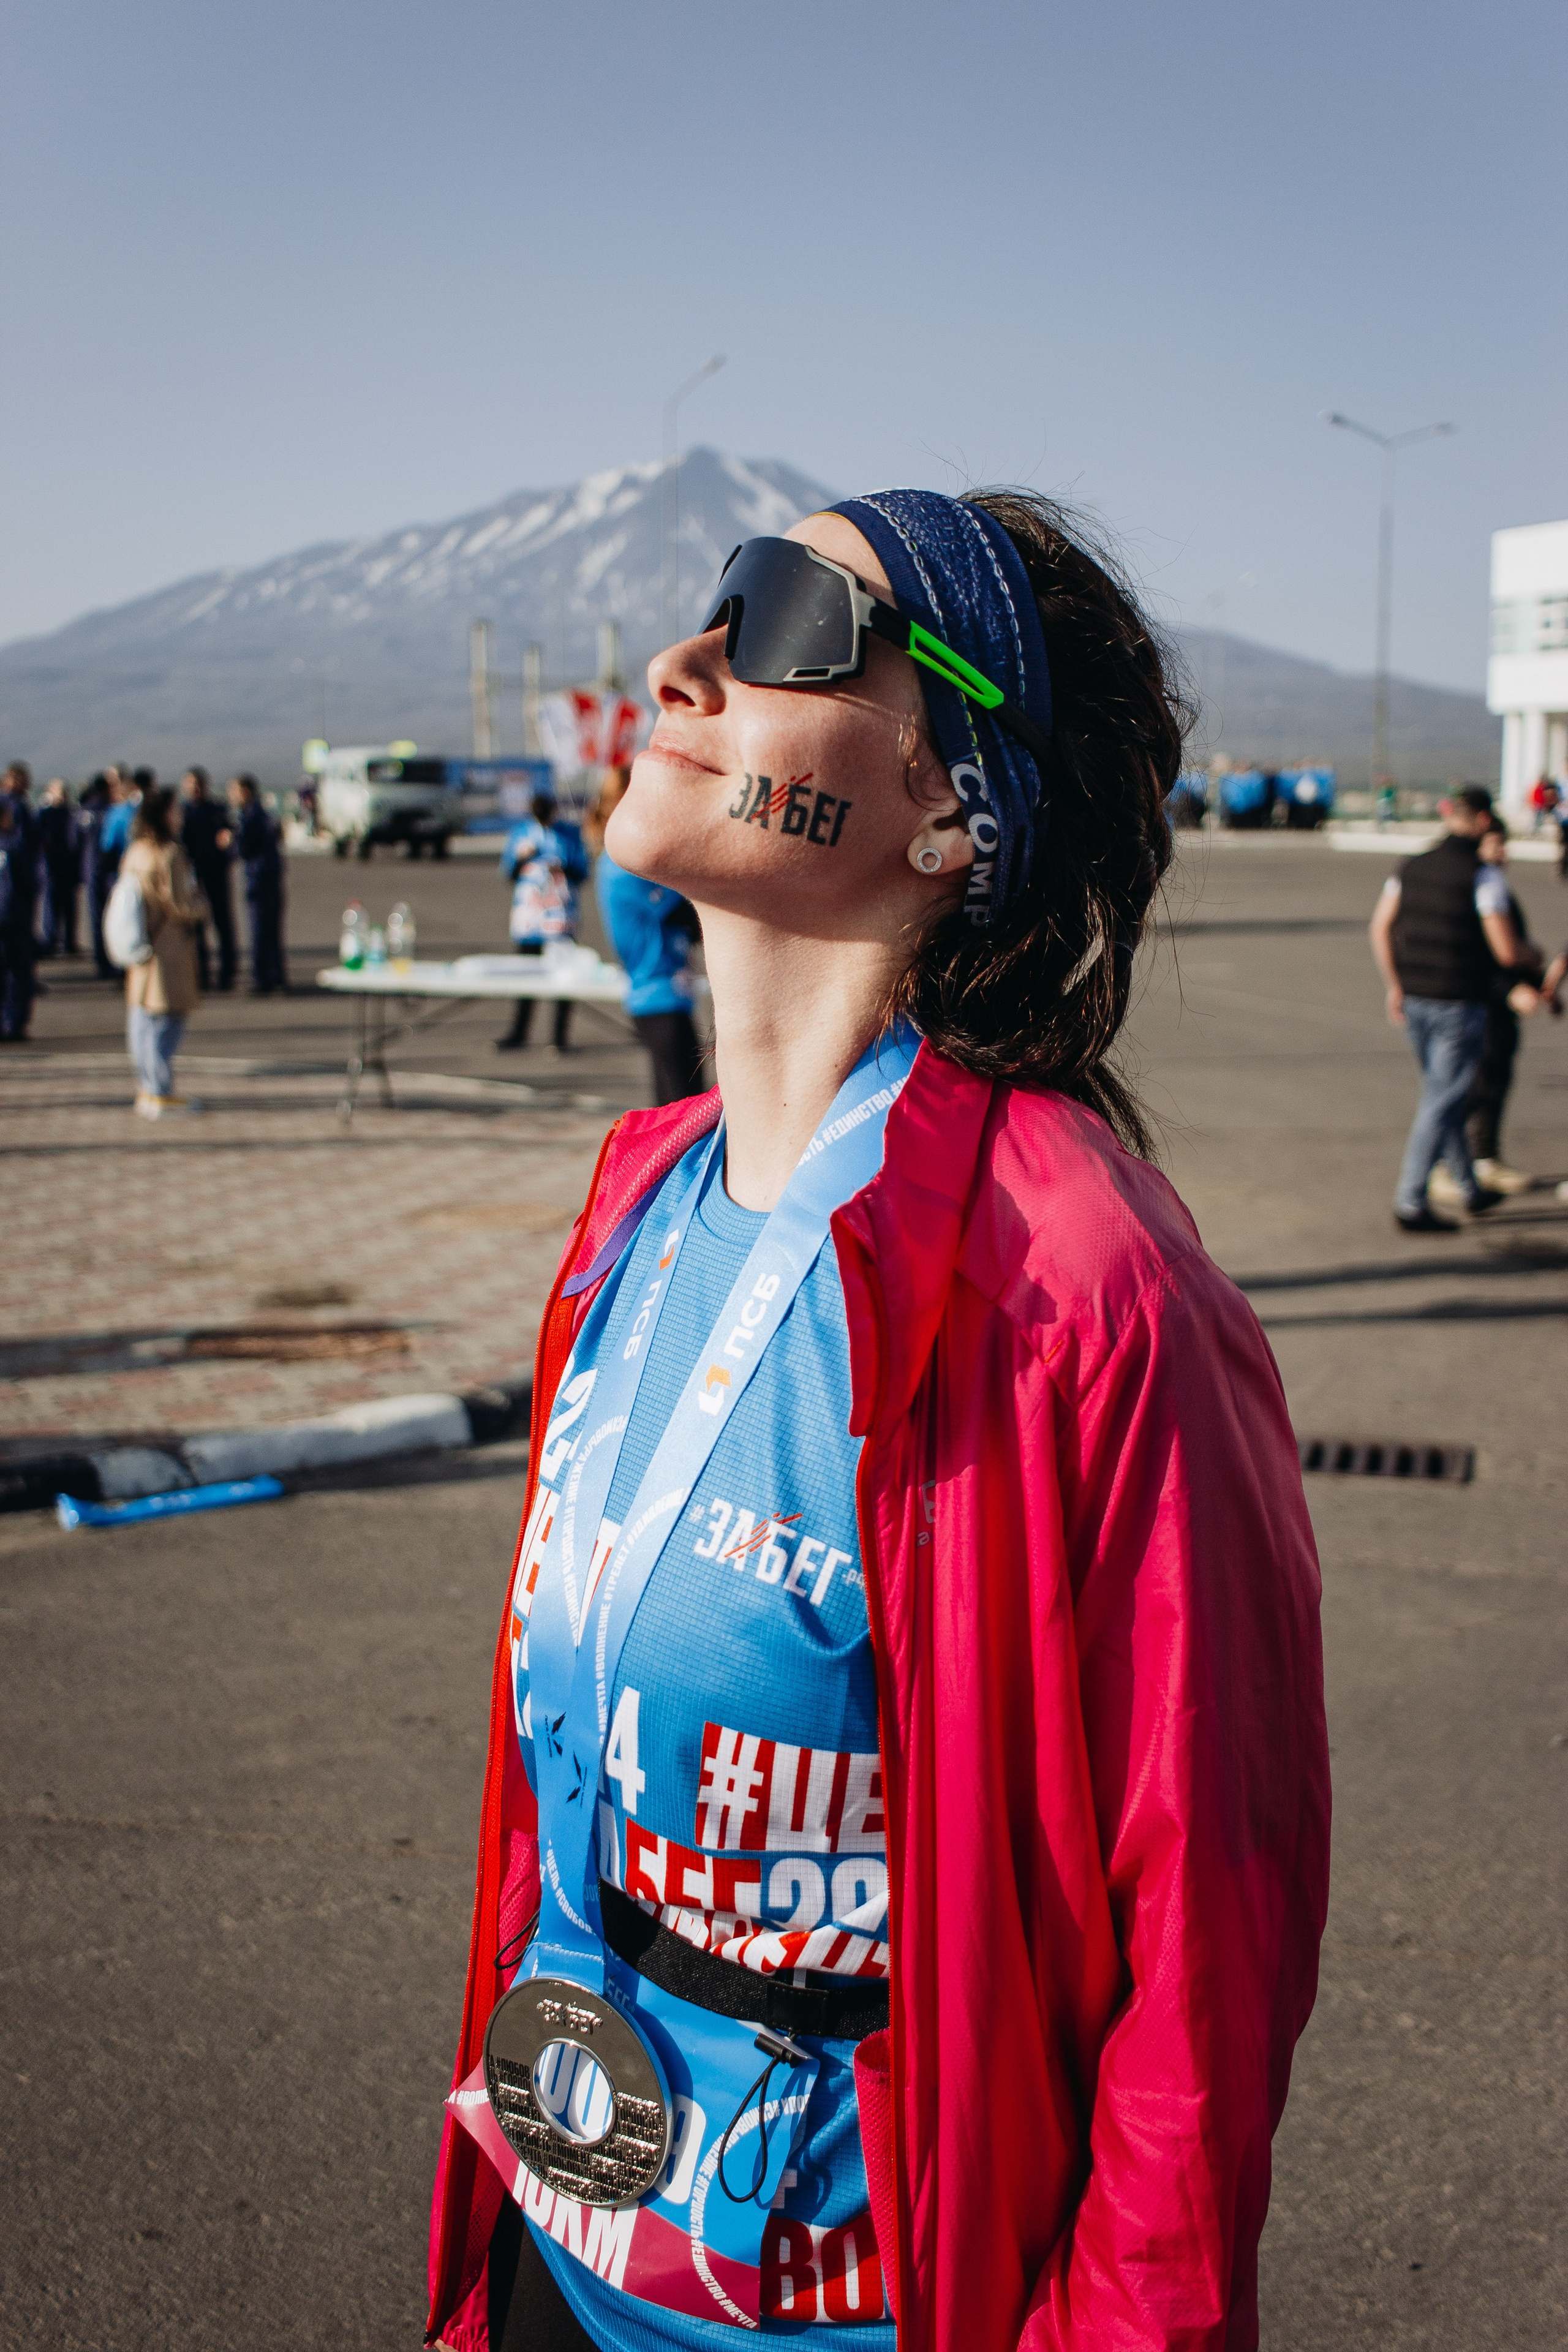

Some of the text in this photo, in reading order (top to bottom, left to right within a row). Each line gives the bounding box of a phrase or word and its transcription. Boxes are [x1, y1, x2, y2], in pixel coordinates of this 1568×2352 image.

[729, 773, 852, 847] ЗАБЕГ
[822, 1088, 894, 1145] #ЕДИНСТВО
[623, 1281, 660, 1360] ПСБ
[724, 1272, 781, 1358] ПСБ
[595, 1602, 611, 1680] #ВОЛНЕНИЕ
[603, 1544, 629, 1601] #ТРЕПЕТ
[546, 1849, 560, 1891] #ЦЕЛЬ
[690, 2173, 710, 2239] #ГОРДОСТЬ
[692, 2238, 727, 2300] #ЕДИНСТВО
[718, 2296, 758, 2329] #МЕЧТА
